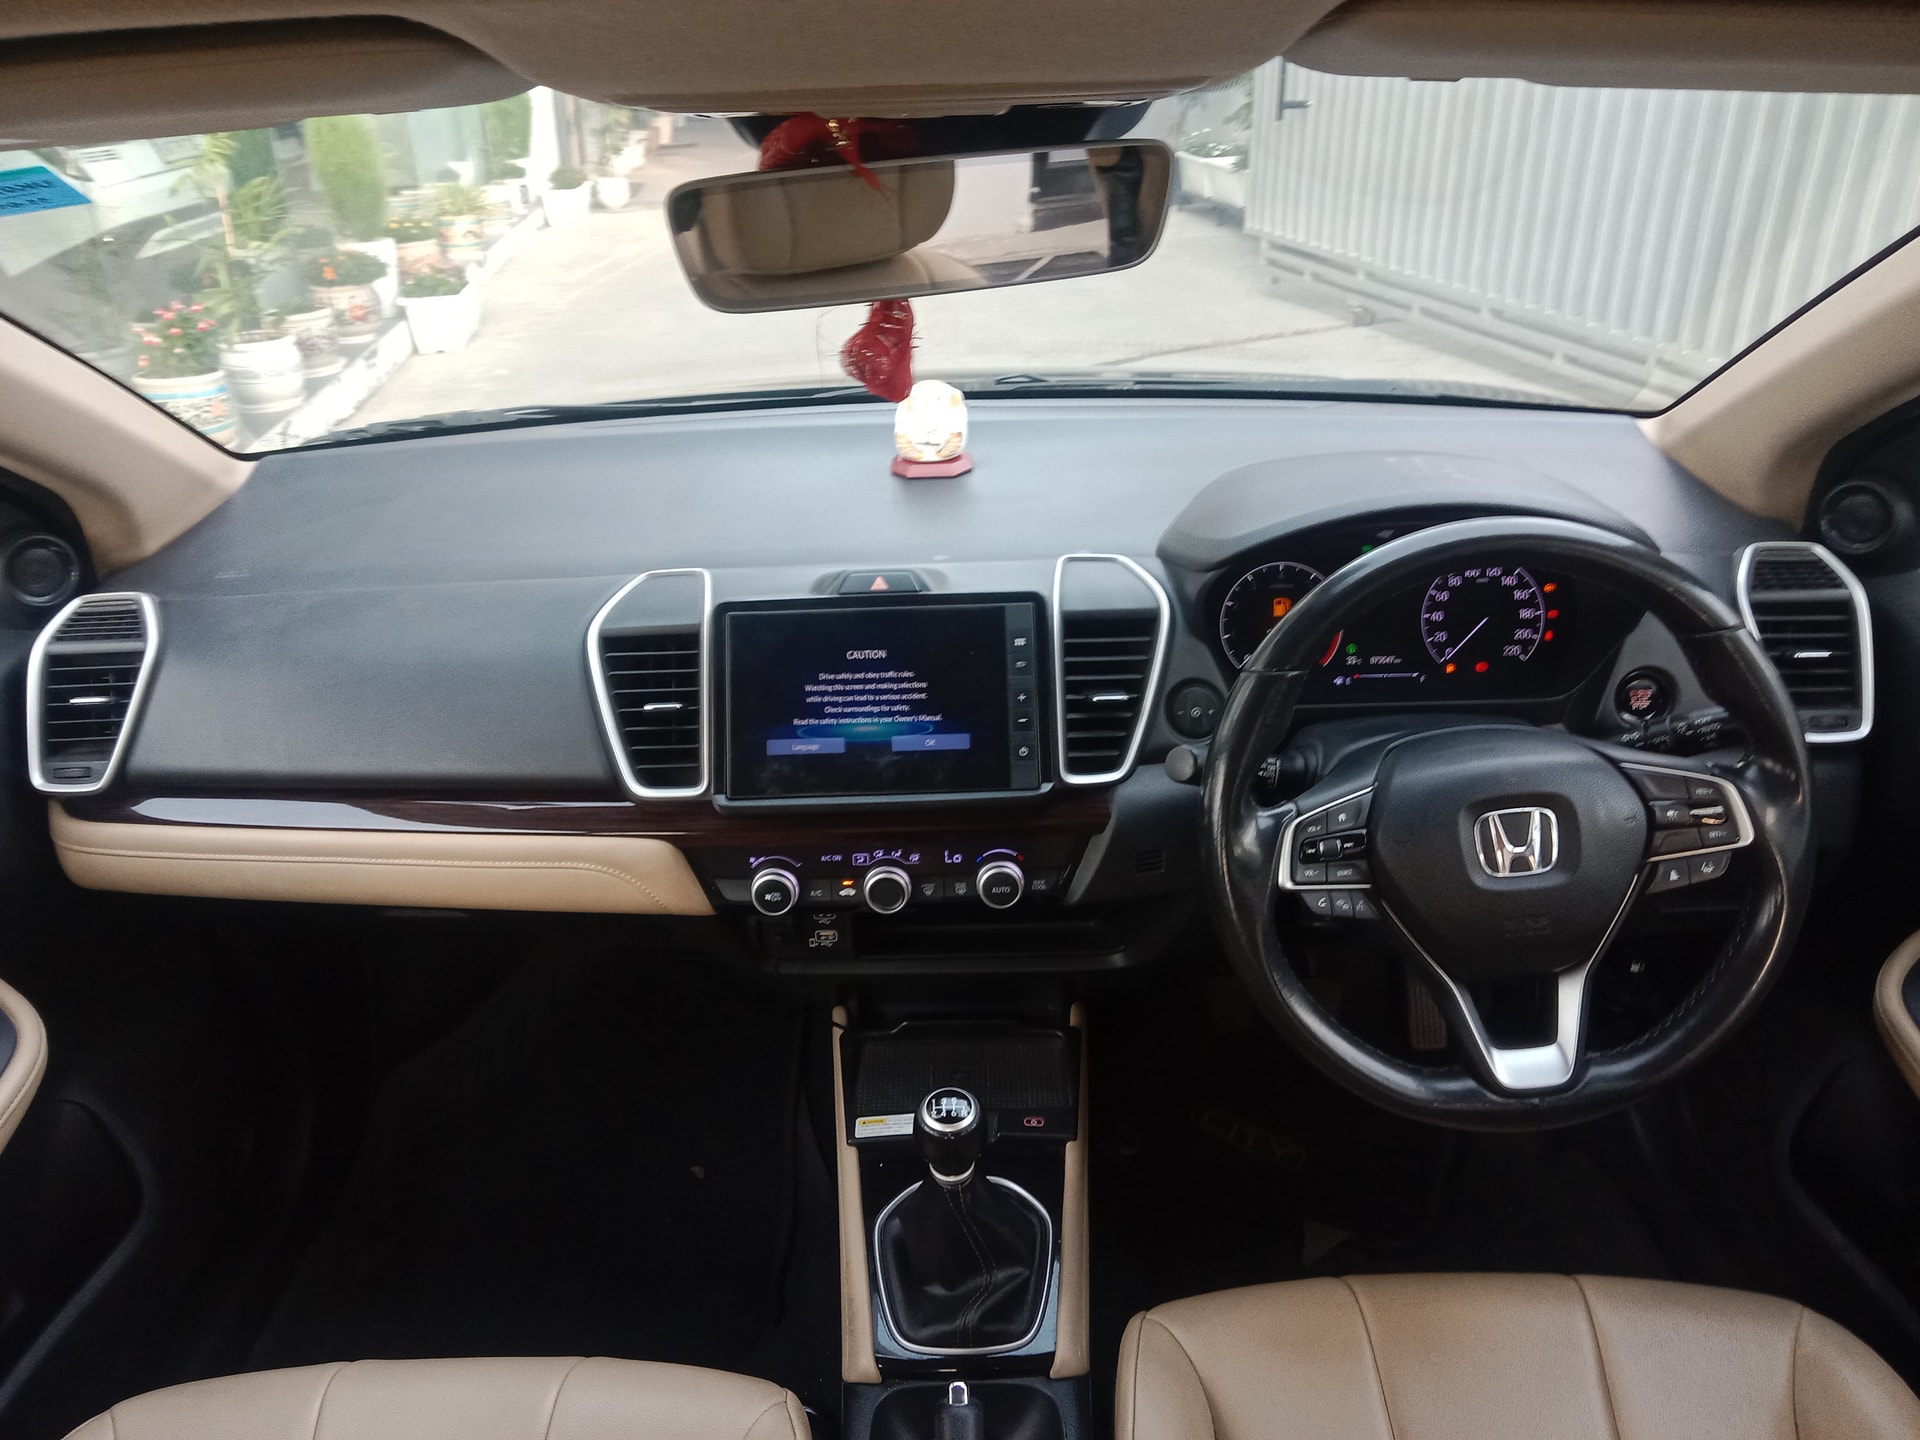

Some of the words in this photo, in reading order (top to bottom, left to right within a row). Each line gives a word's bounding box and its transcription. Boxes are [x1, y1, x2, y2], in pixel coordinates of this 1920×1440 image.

[1448, 576, 1463, 587] 80
[1501, 575, 1518, 586] 140
[1435, 590, 1450, 602] 60
[1513, 589, 1530, 600] 160
[1430, 611, 1445, 622] 40
[1519, 608, 1536, 620] 180
[1434, 631, 1448, 642] 20
[1514, 628, 1533, 640] 200
[846, 649, 887, 660] CAUTION
[1503, 645, 1522, 656] 220
[818, 672, 835, 680] Drive
[835, 672, 852, 680] safely
[880, 670, 898, 678] traffic
[804, 684, 833, 692] Watching
[876, 682, 897, 690] making
[805, 695, 821, 703] while
[822, 695, 843, 703] driving
[843, 705, 880, 713] surroundings
[880, 704, 890, 712] for
[793, 718, 809, 726] Read
[820, 717, 837, 726] safety
[839, 716, 872, 724] instructions
[879, 716, 893, 724] your
[894, 714, 918, 722] Owner's
[945, 849, 962, 863] Lo
[992, 886, 1011, 894] AUTO
